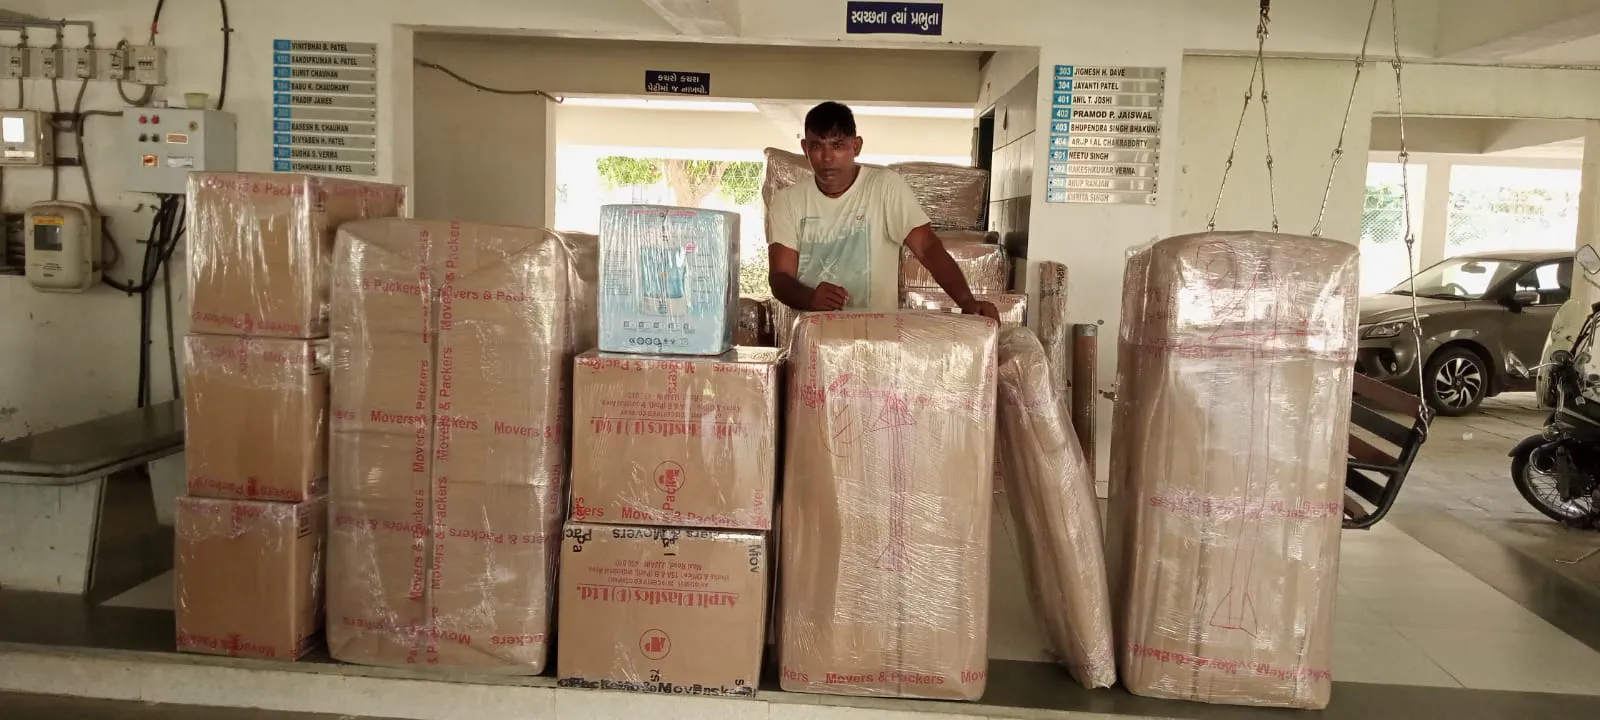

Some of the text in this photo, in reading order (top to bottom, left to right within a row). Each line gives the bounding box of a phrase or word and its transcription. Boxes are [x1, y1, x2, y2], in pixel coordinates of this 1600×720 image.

[851, 7, 939, 31] સ્વચ્છતા ત્યાં પ્રભુતા
[330, 43, 348, 52] PATEL
[340, 58, 357, 66] PATEL
[1059, 67, 1071, 76] 303
[1074, 68, 1100, 76] JIGNESH
[1109, 69, 1126, 77] DAVE
[1058, 81, 1119, 90] 304 JAYANTI PATEL
[1057, 95, 1112, 104] 401 ANIL T. JOSHI
[1056, 109, 1069, 118] 402
[1073, 110, 1107, 118] PRAMOD
[1117, 111, 1153, 119] JAISWAL
[1055, 122, 1068, 132] 403
[1070, 123, 1108, 132] BHUPENDRA
[1109, 124, 1128, 133] SINGH
[328, 137, 345, 145] PATEL
[1103, 139, 1148, 147] CHAKRABORTY
[319, 151, 338, 159] VERMA
[1069, 151, 1089, 160] NEETU
[1090, 152, 1109, 160] SINGH
[335, 165, 353, 173] PATEL
[1114, 167, 1136, 176] VERMA
[440, 347, 452, 397] Packers
[370, 410, 416, 425] Movers
[494, 421, 540, 437] Movers
[412, 428, 425, 473] Movers
[449, 528, 504, 544] Packers
[507, 534, 518, 545] &
[612, 528, 663, 541] Movers
[576, 585, 738, 609] Arpit Plastics (P) Ltd.
[825, 671, 874, 684] Movers
[878, 671, 887, 682] &
[889, 671, 944, 685] Packers
